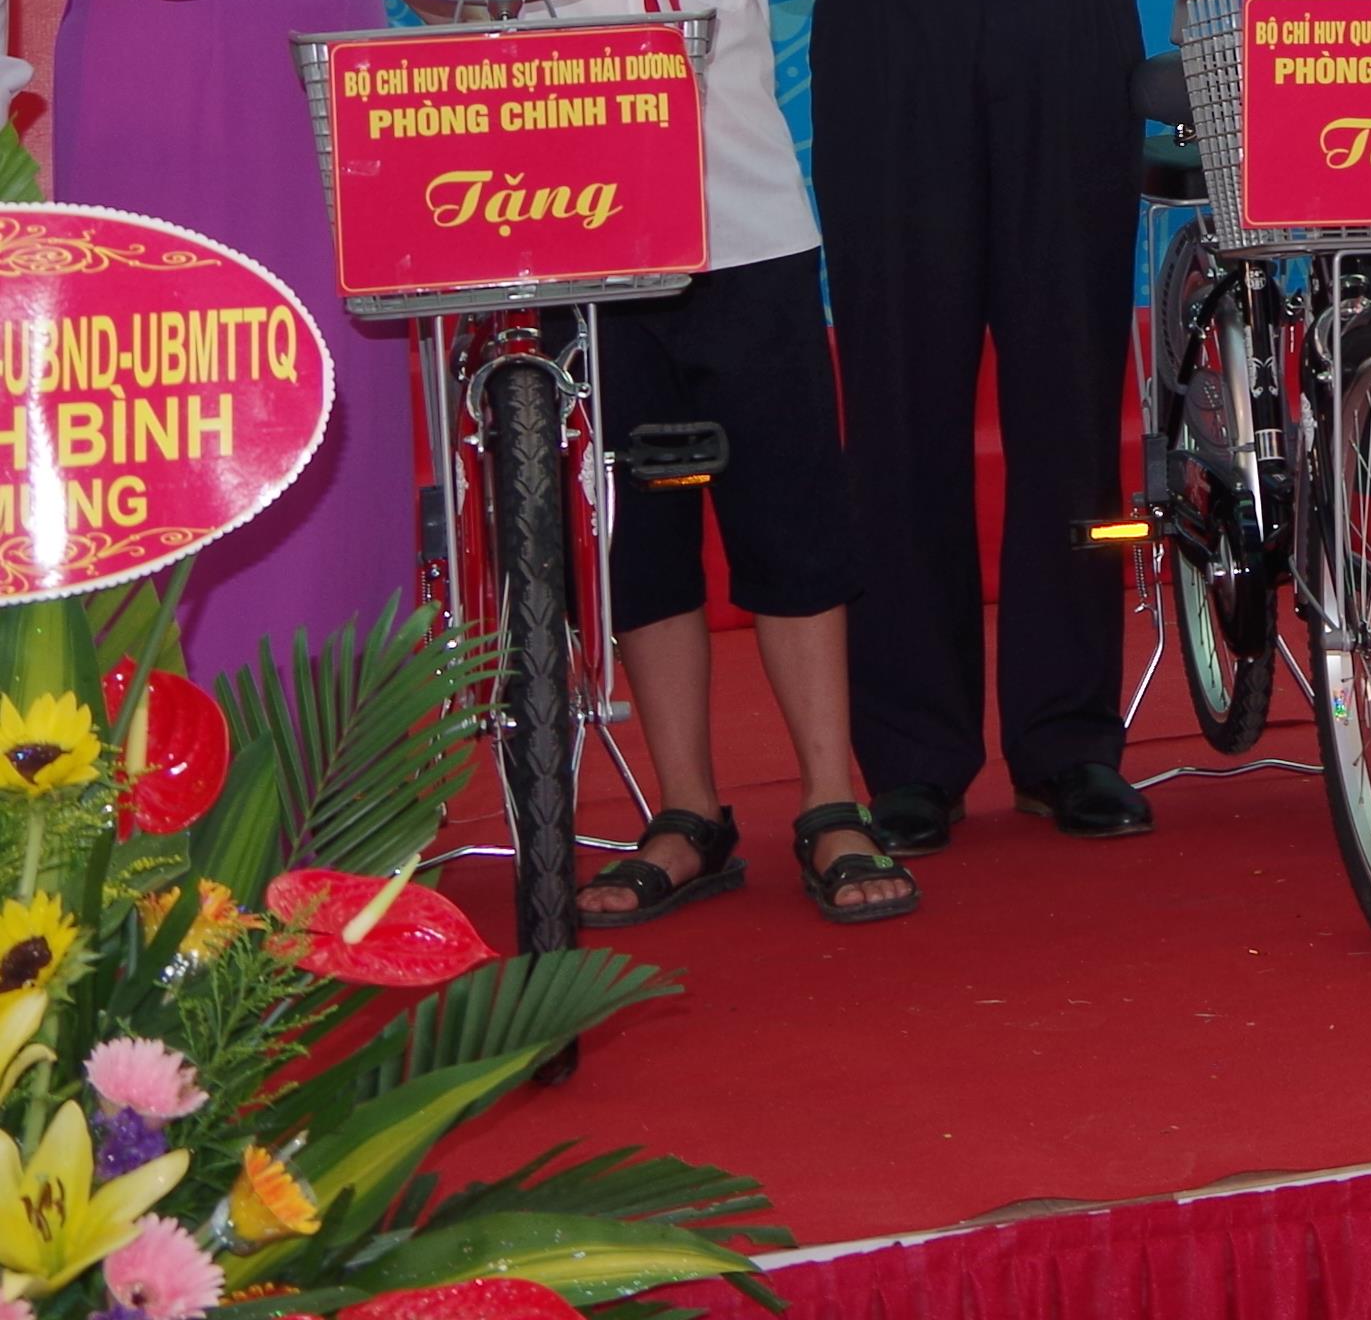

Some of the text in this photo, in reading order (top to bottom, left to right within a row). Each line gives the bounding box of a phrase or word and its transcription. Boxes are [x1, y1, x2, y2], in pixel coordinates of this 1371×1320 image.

[1255, 16, 1279, 50] BỘ
[1282, 12, 1311, 45] CHỈ
[1314, 20, 1346, 45] HUY
[344, 46, 687, 102] BỘ CHỈ HUY QUÂN SỰ TỈNH HẢI DƯƠNG
[368, 92, 670, 140] PHÒNG CHÍNH TRỊ
[425, 169, 624, 238] Tặng
[0, 304, 298, 396] UBND-UBMTTQ
[57, 383, 235, 469] BÌNH
